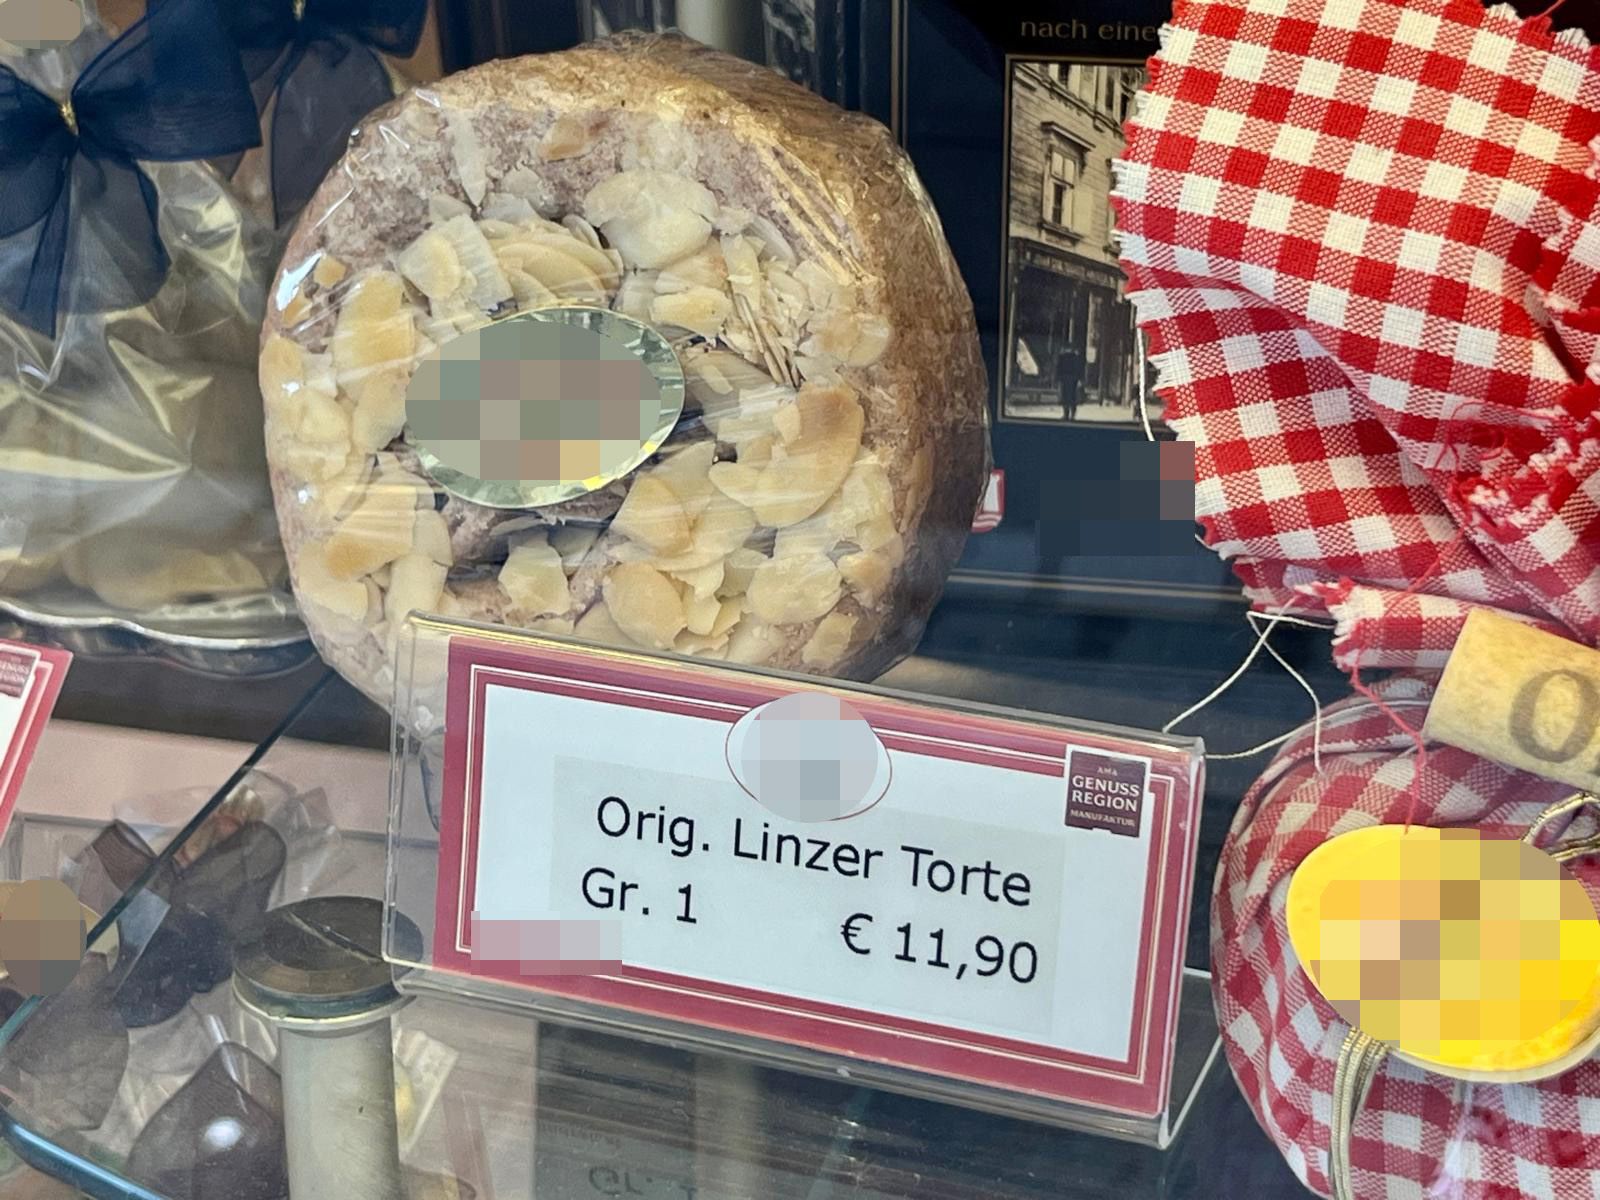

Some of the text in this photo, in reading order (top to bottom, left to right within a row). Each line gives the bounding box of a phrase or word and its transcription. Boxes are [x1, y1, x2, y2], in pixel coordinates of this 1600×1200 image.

[1020, 18, 1088, 39] nach
[1510, 668, 1600, 764] O
[1071, 775, 1140, 797] GENUSS
[1071, 789, 1138, 812] REGION
[597, 796, 1031, 906] Orig. Linzer Torte
[582, 867, 1038, 984] Gr. 1 € 11,90
